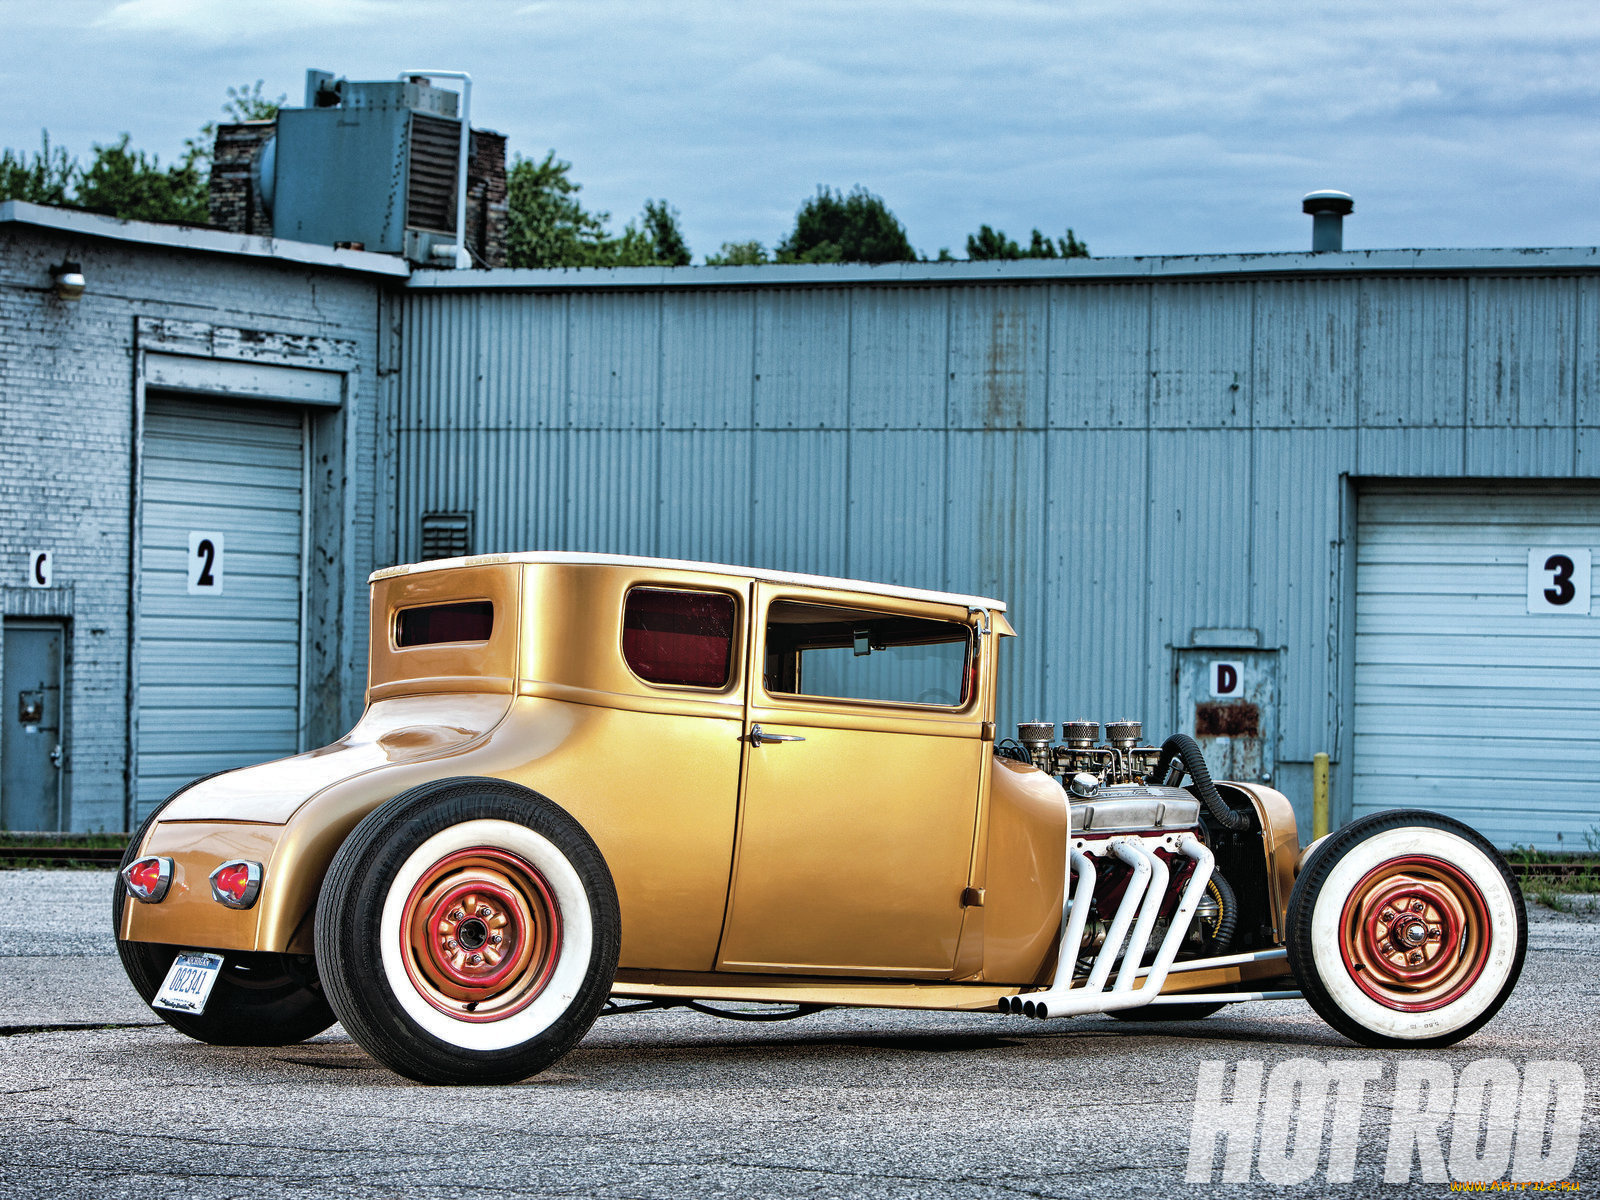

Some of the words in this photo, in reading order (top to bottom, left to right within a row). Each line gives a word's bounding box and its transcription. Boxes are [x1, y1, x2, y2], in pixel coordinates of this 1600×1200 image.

[35, 553, 46, 585] C
[197, 539, 215, 586] 2
[1544, 554, 1576, 606] 3
[1217, 664, 1238, 694] D
